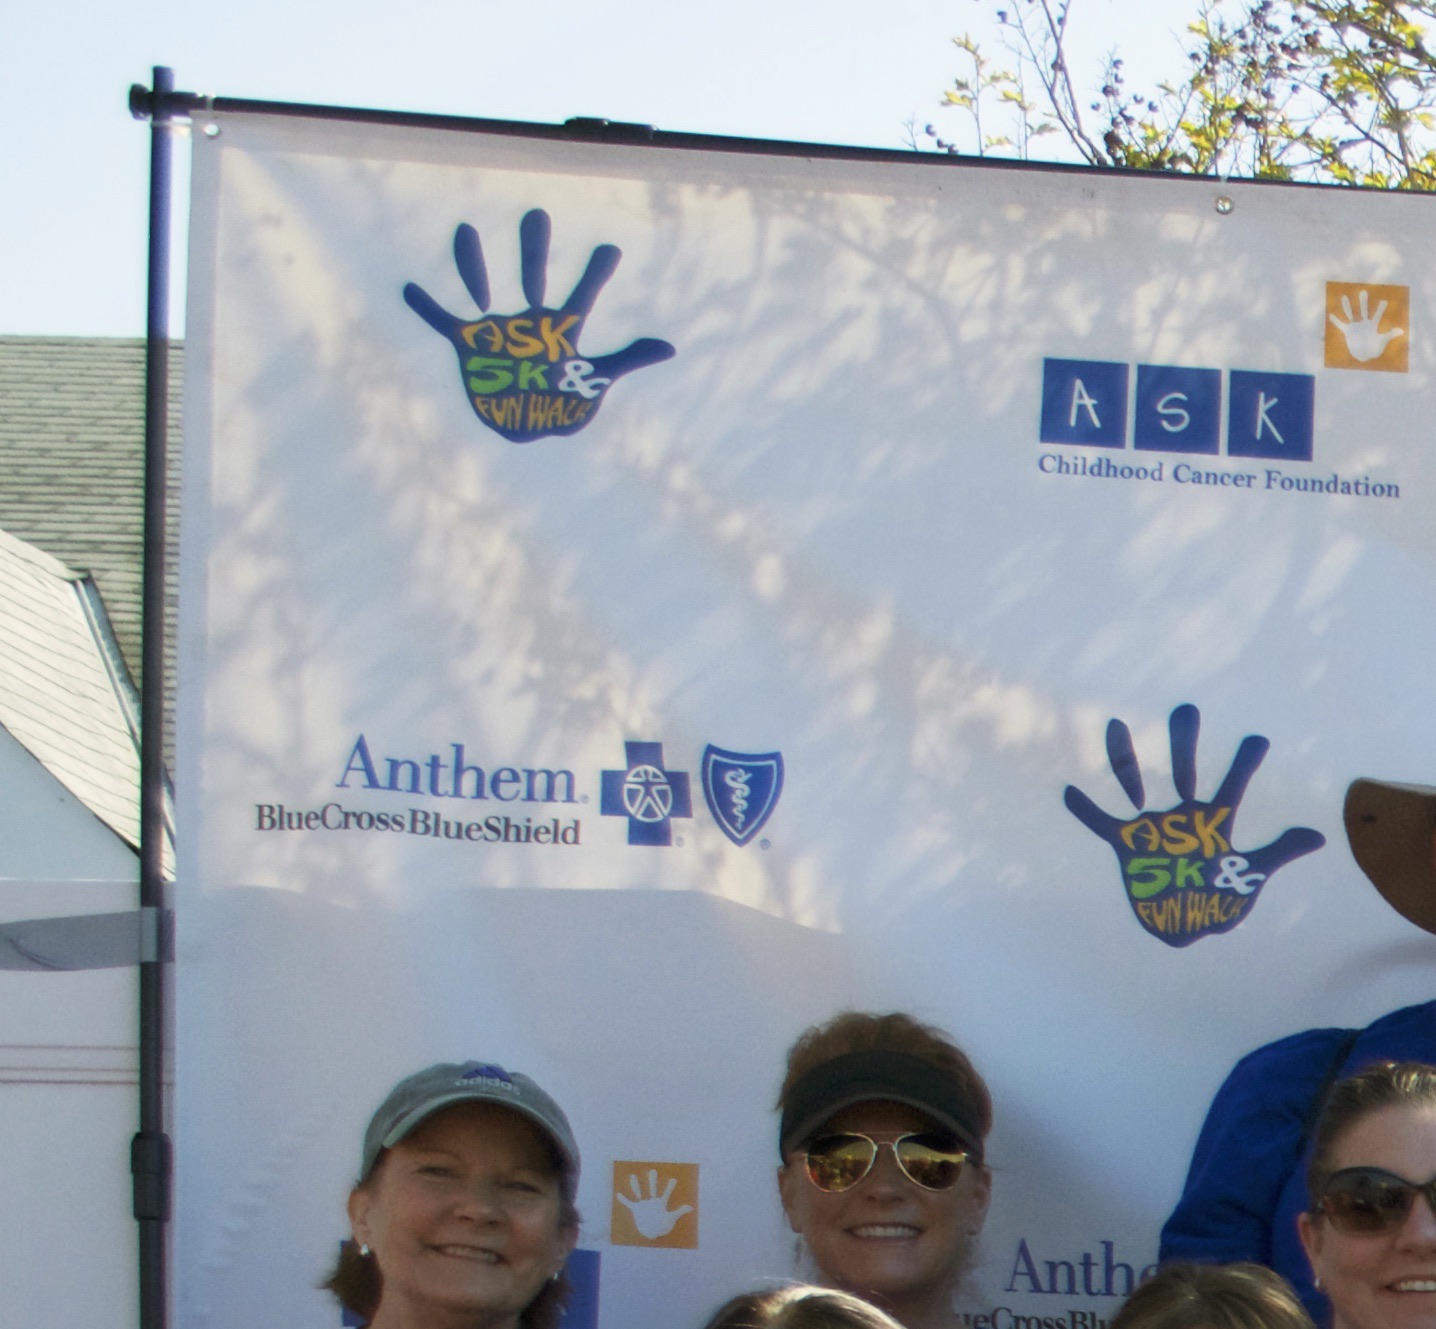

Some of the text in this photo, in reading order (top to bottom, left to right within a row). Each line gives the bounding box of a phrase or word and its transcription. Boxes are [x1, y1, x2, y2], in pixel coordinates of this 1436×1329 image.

[461, 315, 580, 363] ASK
[475, 393, 524, 431] FUN
[1038, 453, 1400, 498] Childhood Cancer Foundation
[335, 733, 578, 804] Anthem
[1120, 807, 1231, 859] ASK
[1137, 893, 1182, 934] FUN
